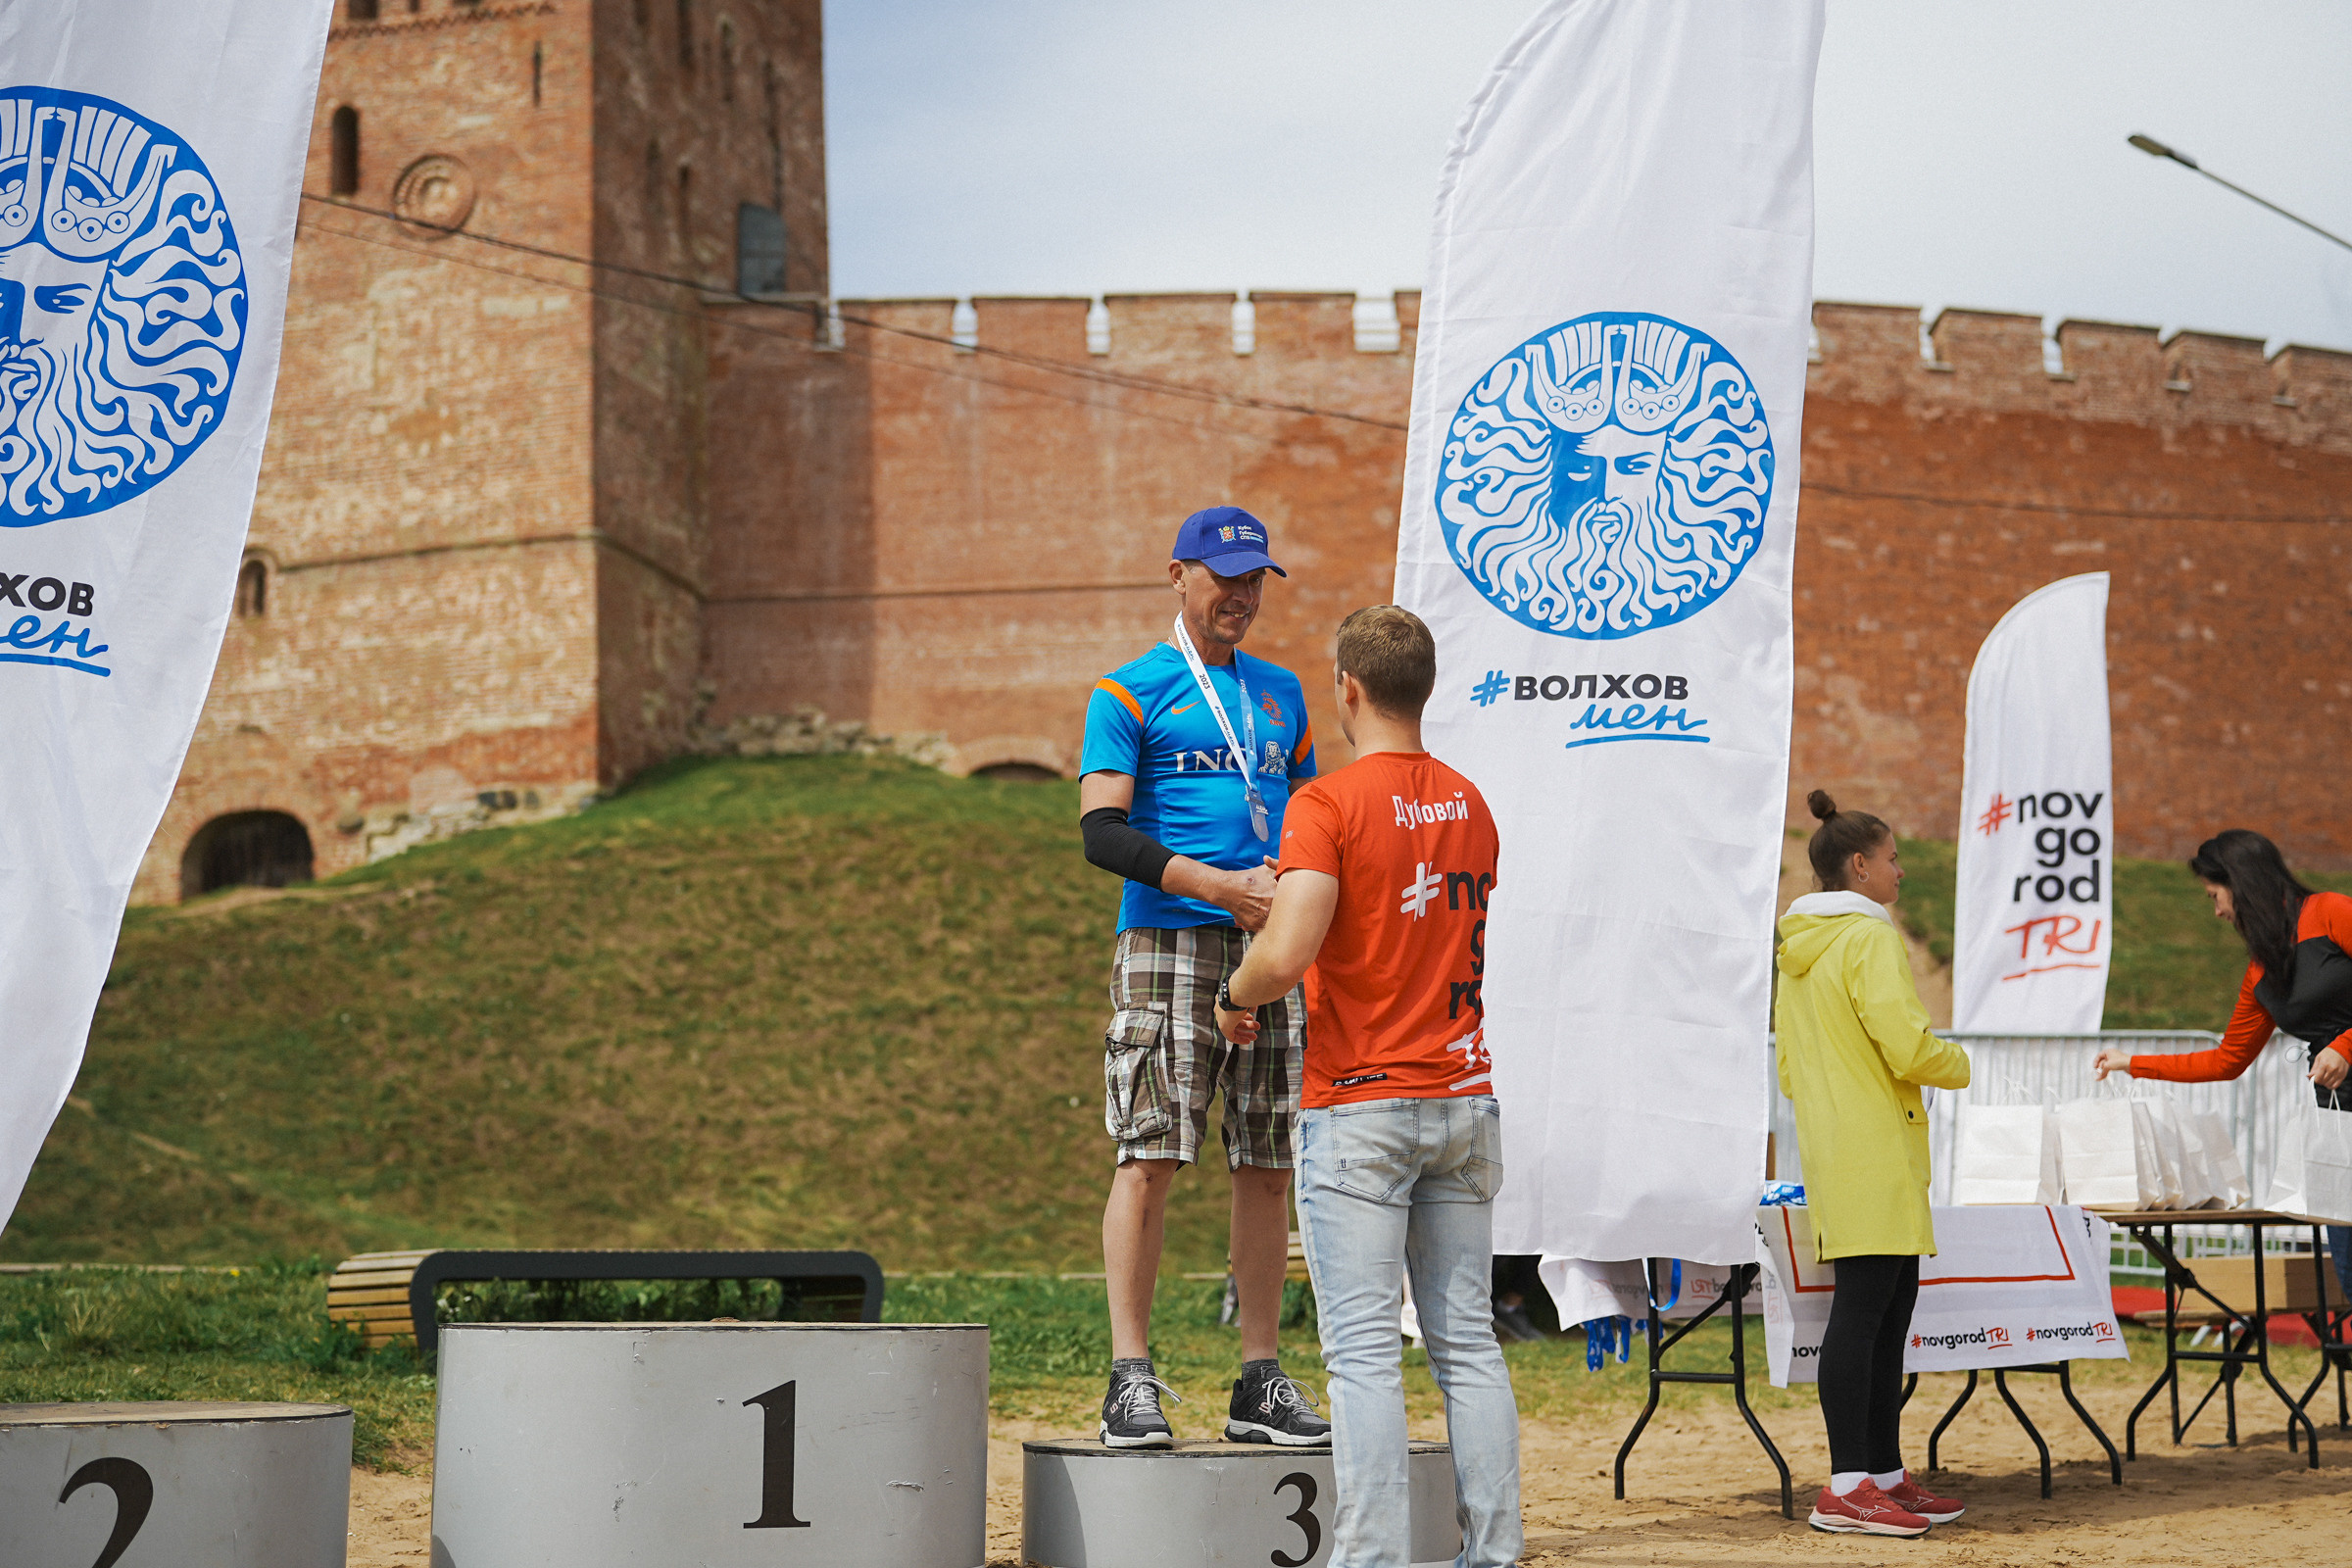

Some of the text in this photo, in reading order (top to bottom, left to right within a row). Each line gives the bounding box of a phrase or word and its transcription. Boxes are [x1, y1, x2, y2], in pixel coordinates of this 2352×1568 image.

[1200, 674, 1210, 690] 2023
[1392, 792, 1469, 830] Дубовой
[1977, 792, 2103, 838] #nov
[2035, 827, 2101, 868] go
[2013, 859, 2100, 903] rod
[2005, 914, 2102, 959] TRI
[742, 1380, 811, 1529] 1
[59, 1456, 154, 1568] 2
[1270, 1472, 1321, 1567] 3
